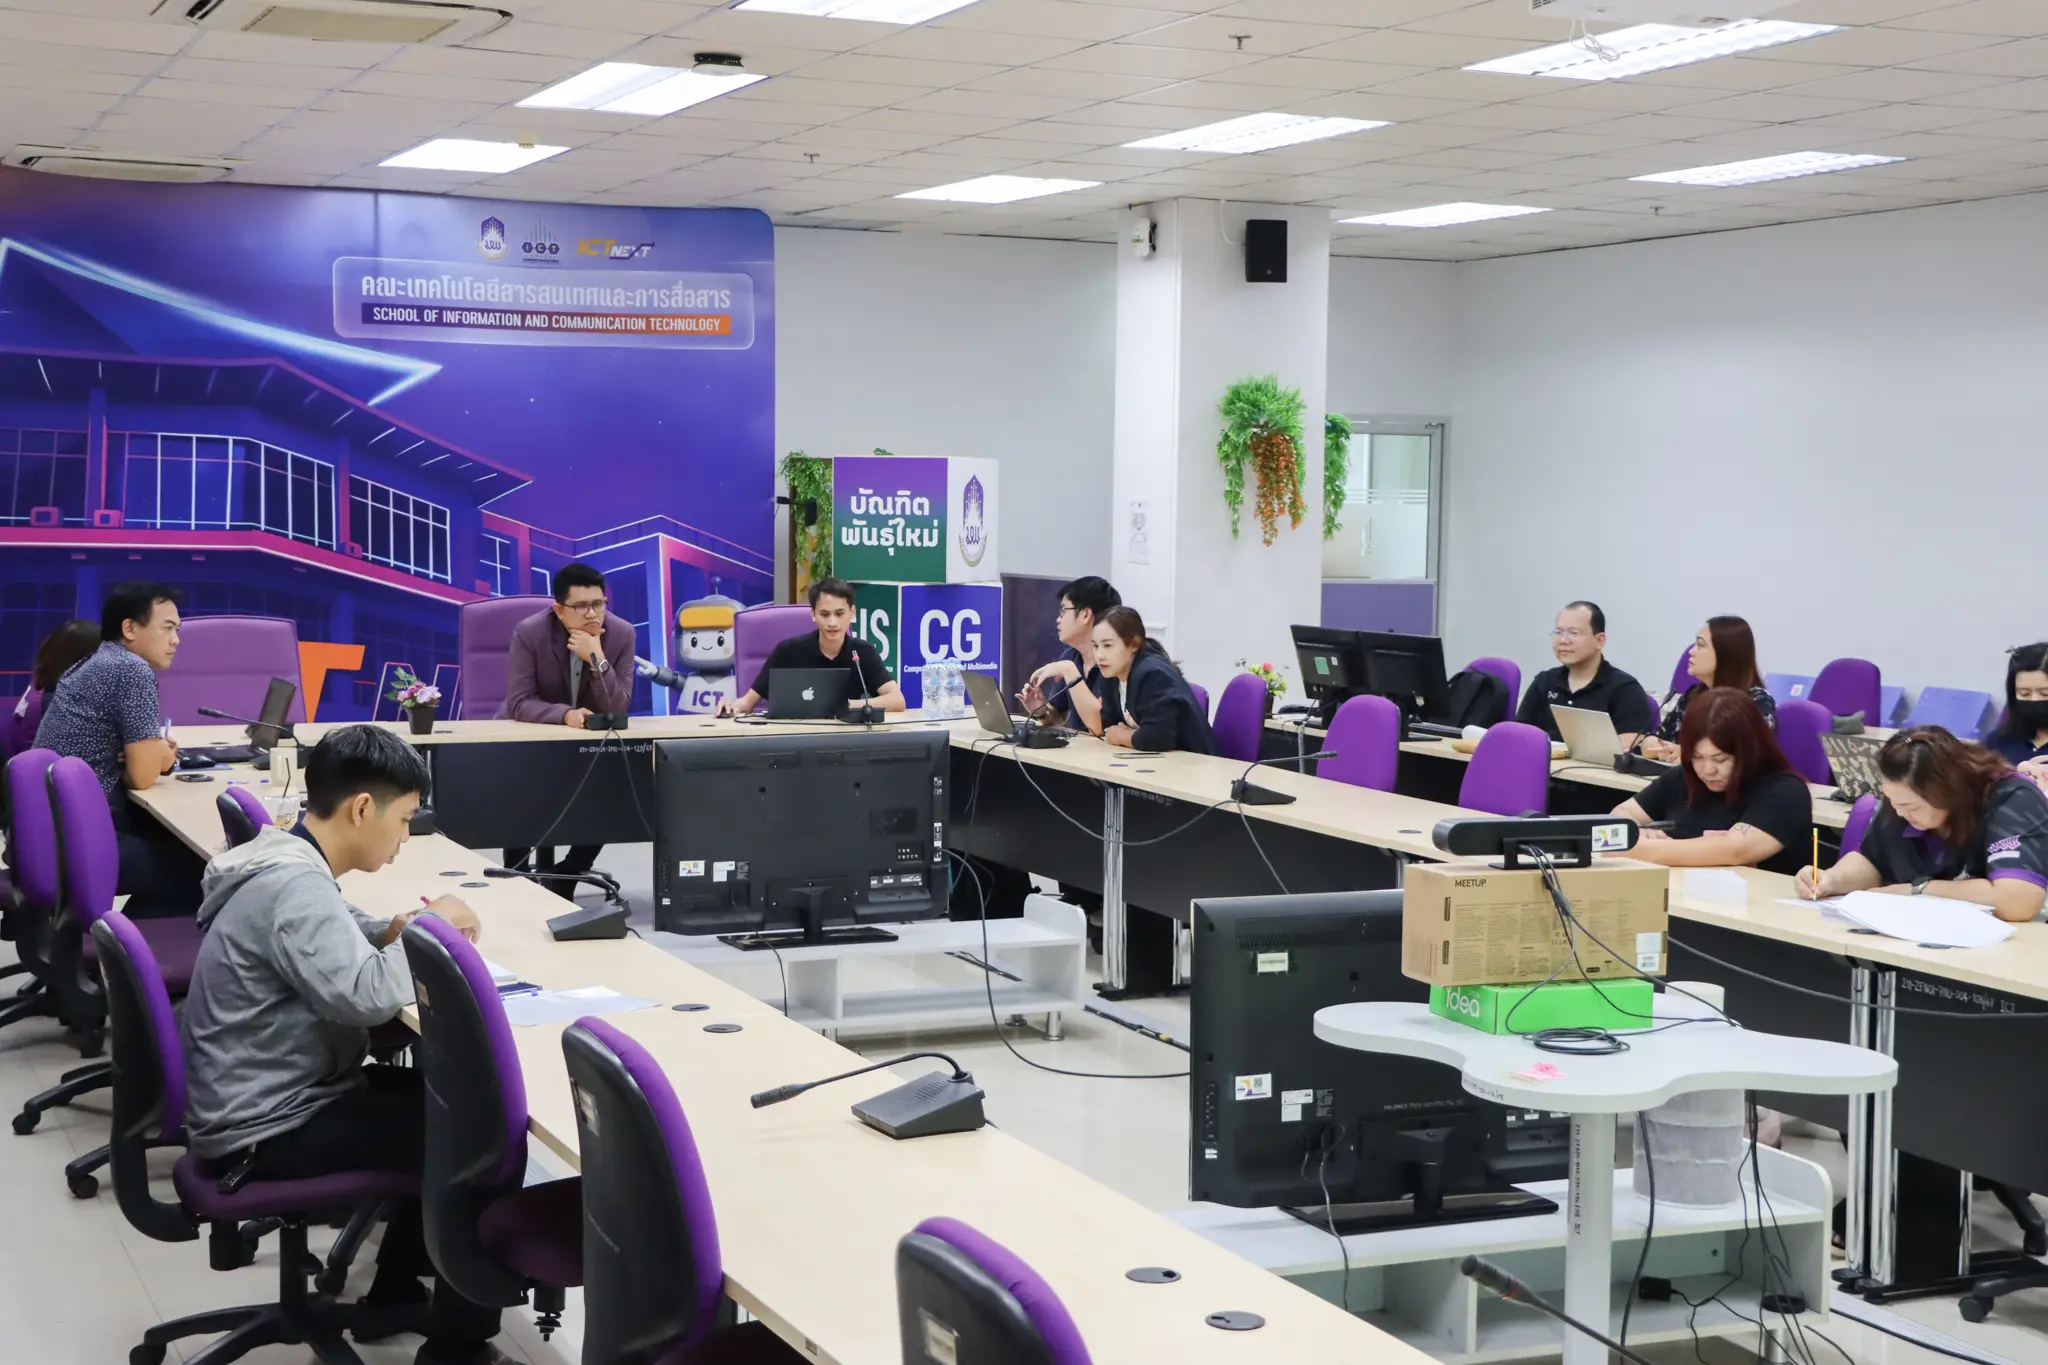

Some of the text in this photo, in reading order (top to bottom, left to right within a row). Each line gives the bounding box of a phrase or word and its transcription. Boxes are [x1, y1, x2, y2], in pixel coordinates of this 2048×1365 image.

[577, 238, 654, 259] ICT NEXT
[361, 275, 731, 309] คณะเทคโนโลยีสารสนเทศและการสื่อสาร
[373, 307, 721, 332] SCHOOL OF INFORMATION AND COMMUNICATION TECHNOLOGY
[850, 488, 930, 516] บัณฑิต
[841, 517, 939, 556] พันธุ์ใหม่
[851, 608, 982, 662] IS CG
[968, 662, 998, 671] Multimedia
[692, 690, 724, 707] ICT
[1454, 878, 1487, 888] MEETUP
